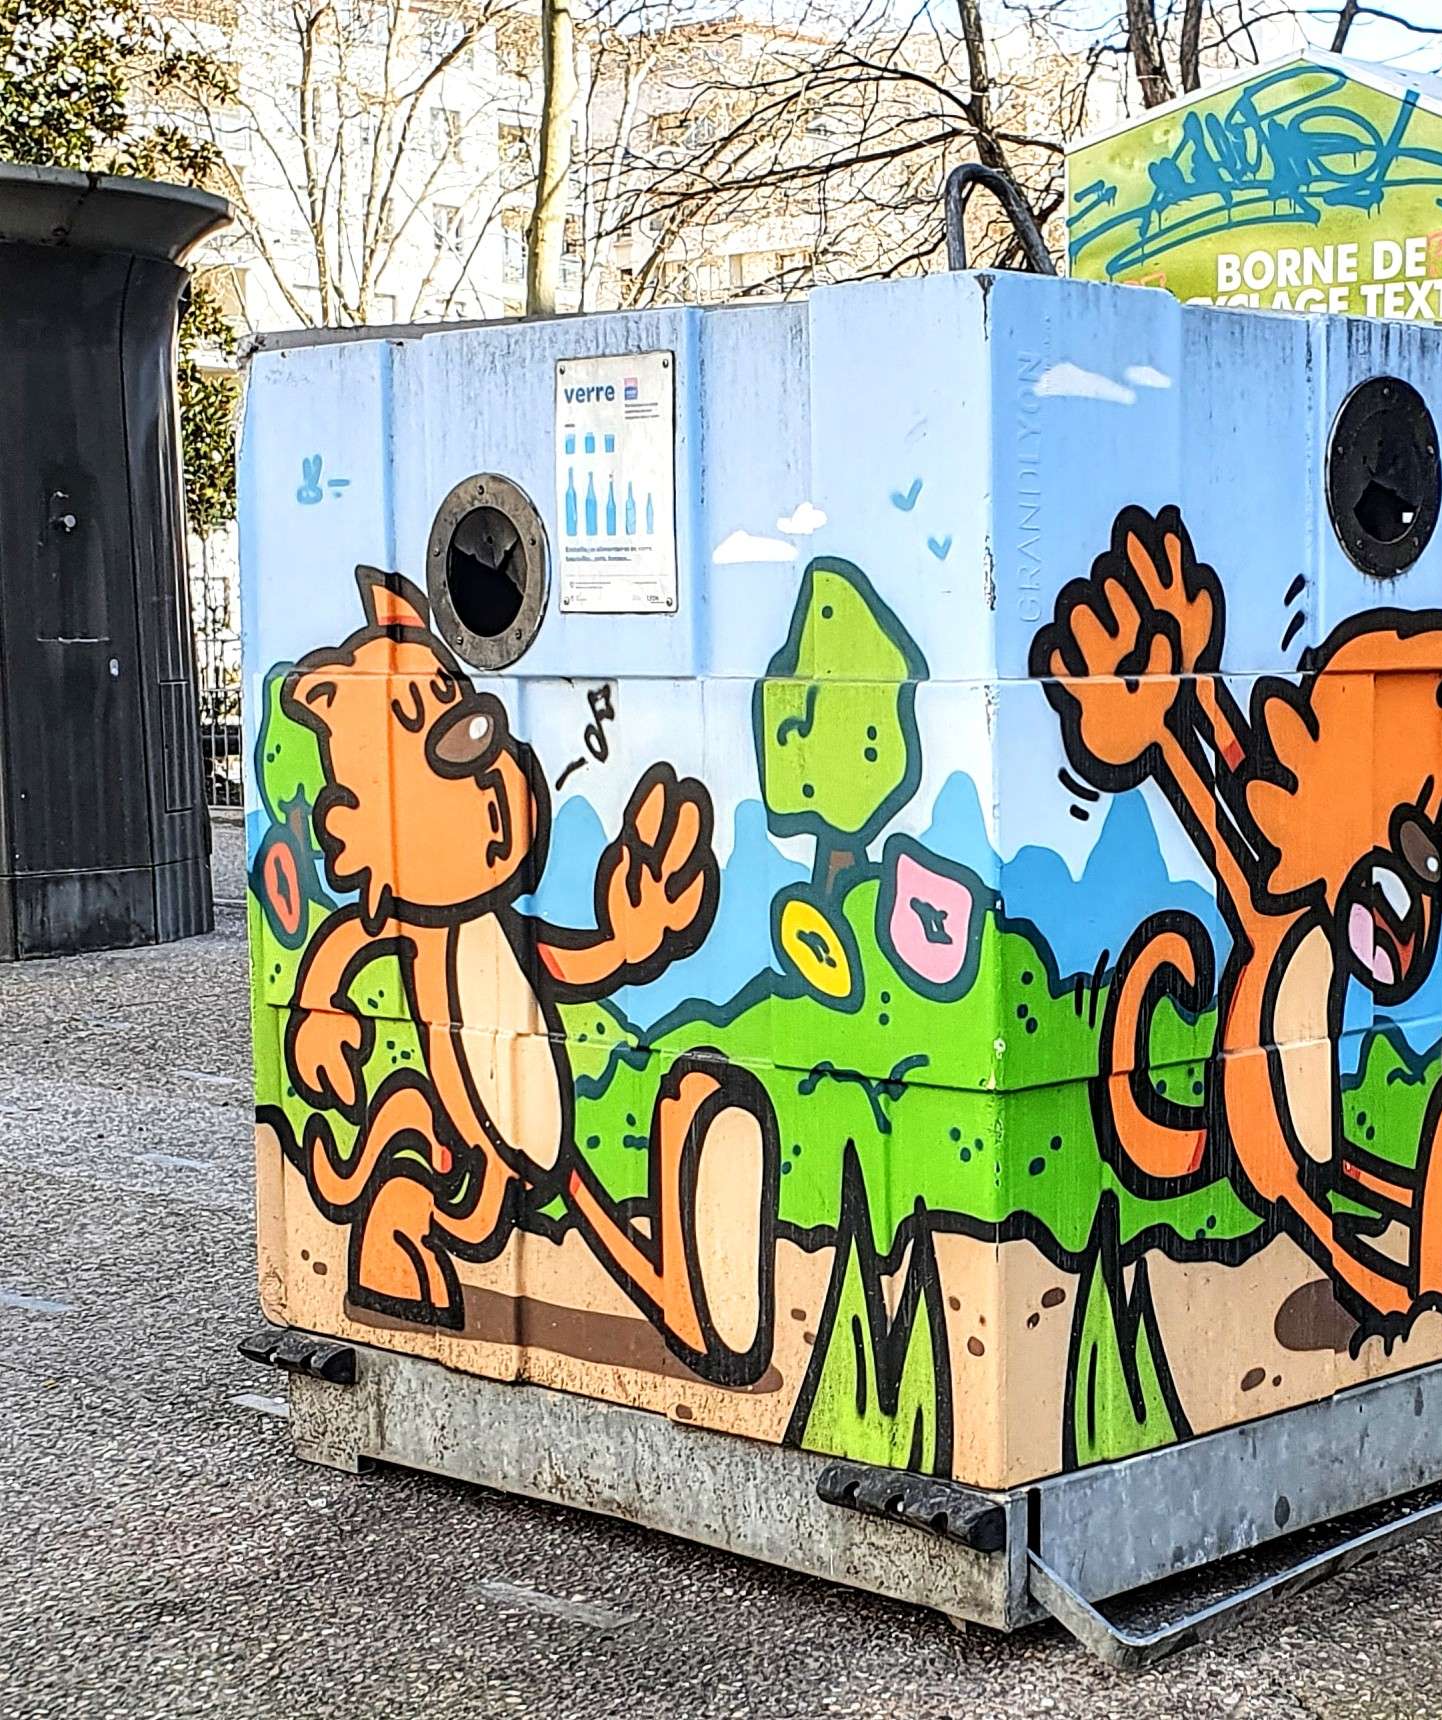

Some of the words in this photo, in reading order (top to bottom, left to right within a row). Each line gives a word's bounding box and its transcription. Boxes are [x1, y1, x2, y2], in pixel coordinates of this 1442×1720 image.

[1216, 243, 1359, 293] BORNE
[1372, 236, 1428, 281] DE
[563, 385, 616, 404] verre
